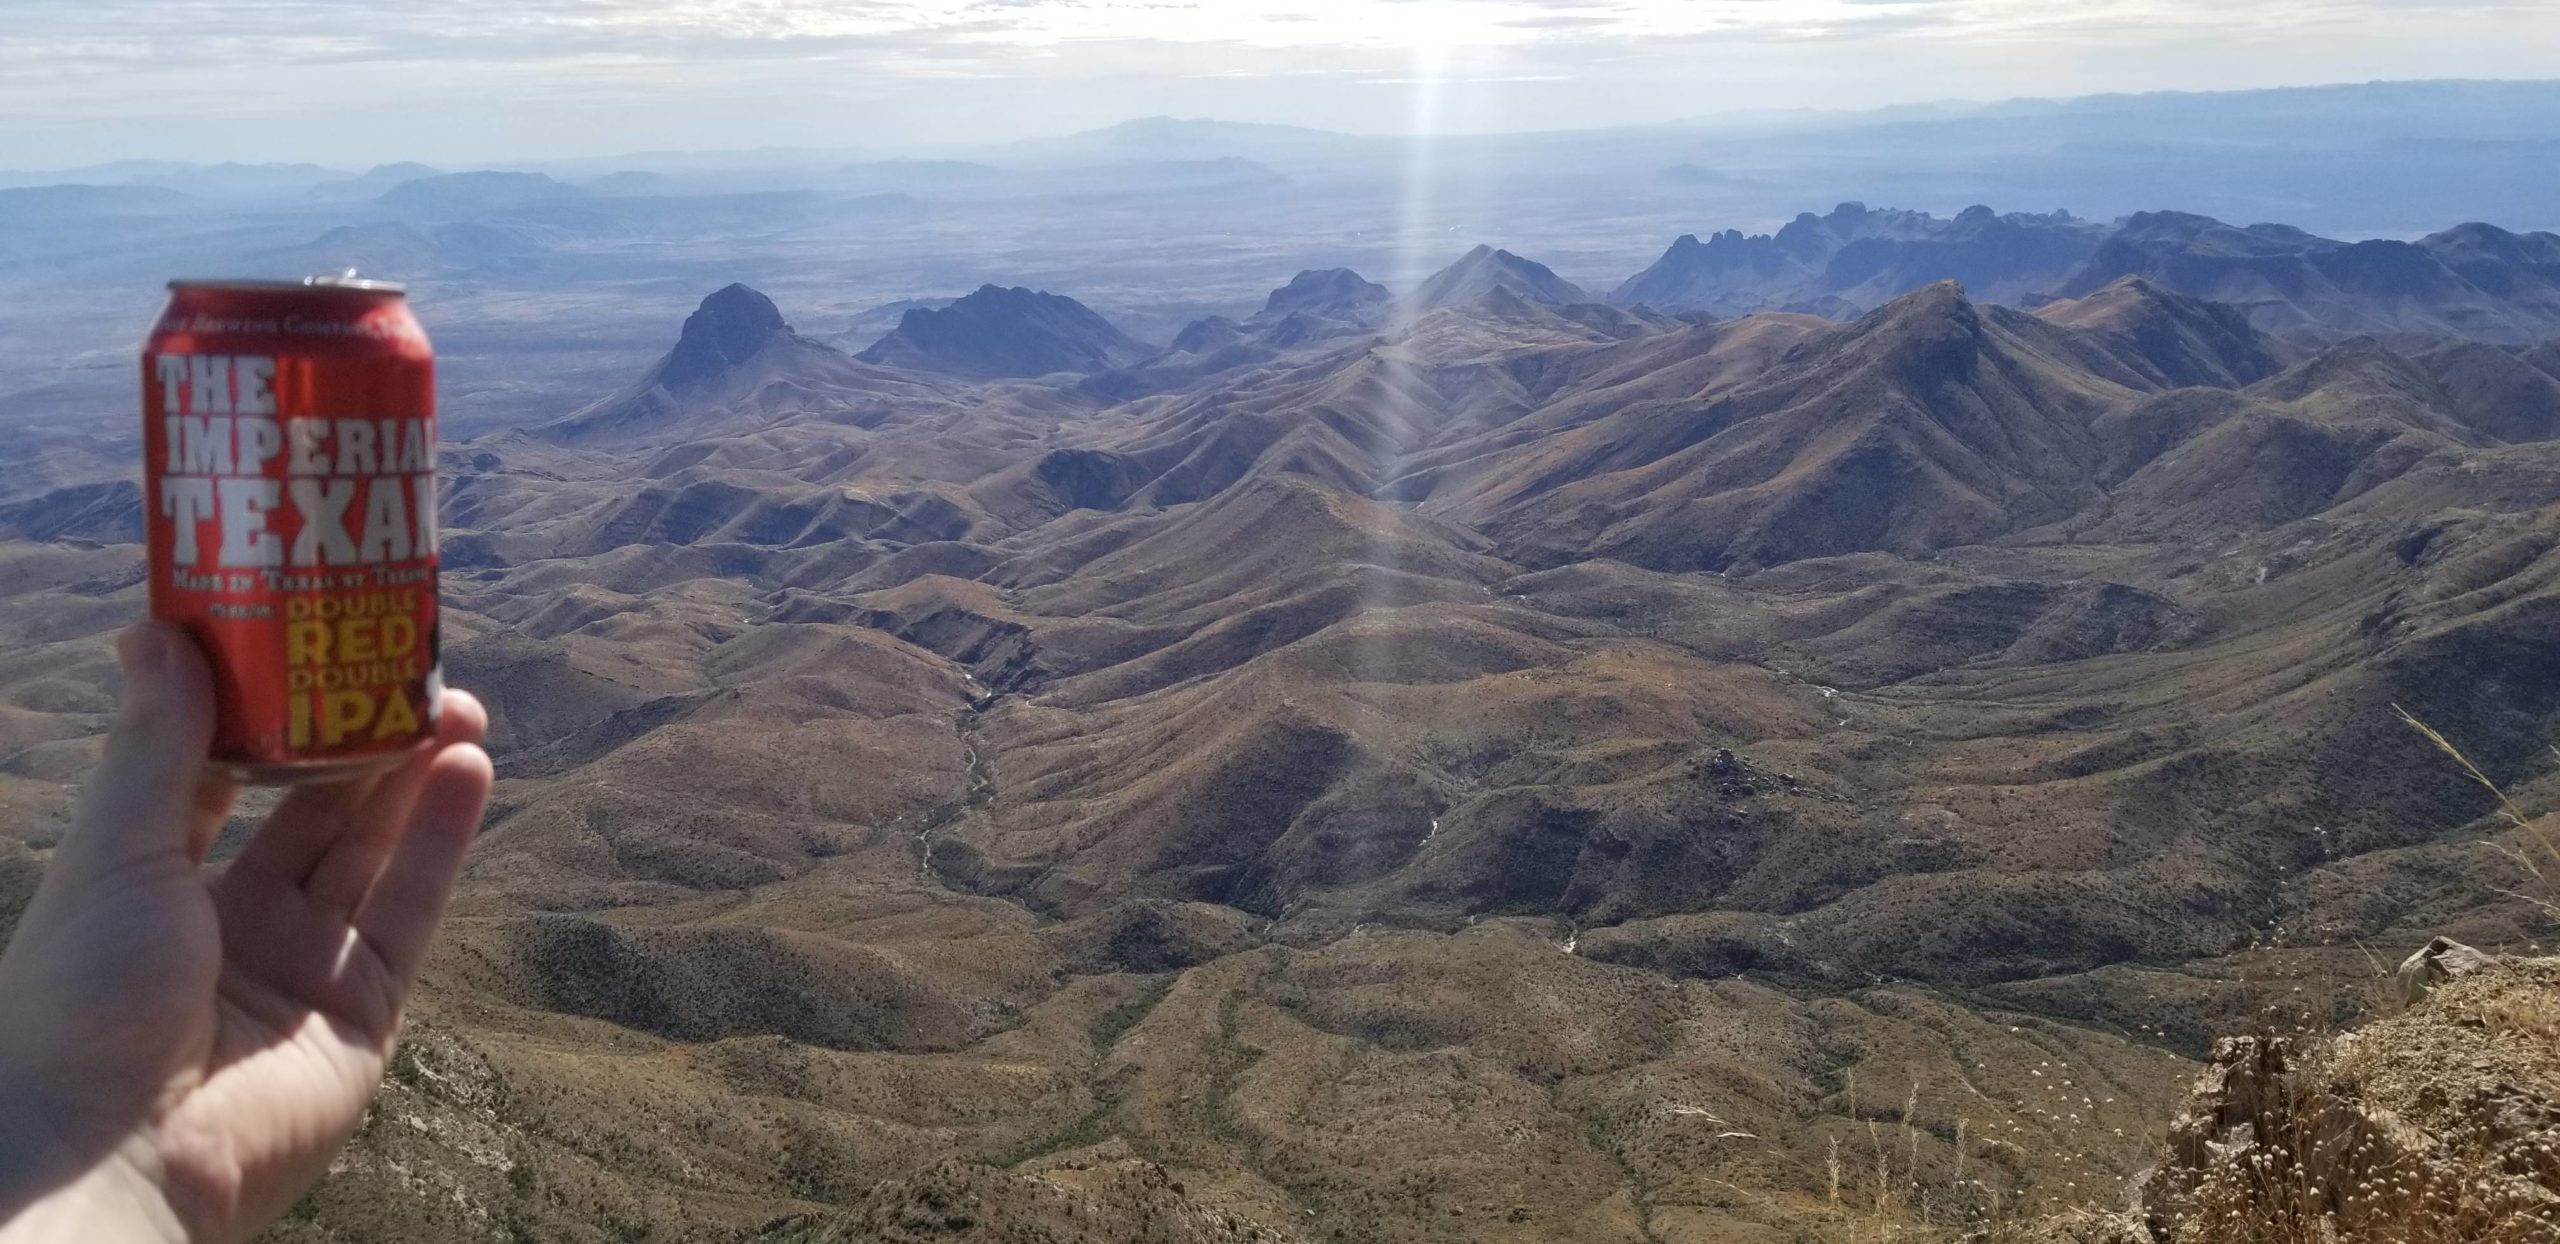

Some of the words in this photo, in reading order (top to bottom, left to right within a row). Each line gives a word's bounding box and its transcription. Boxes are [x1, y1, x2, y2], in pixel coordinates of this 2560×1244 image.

[156, 353, 277, 414] THE
[160, 475, 438, 566] TEXAN
[286, 590, 417, 619] DOUBLE
[287, 615, 417, 666] RED
[287, 660, 418, 691] DOUBLE
[288, 686, 419, 748] IPA
